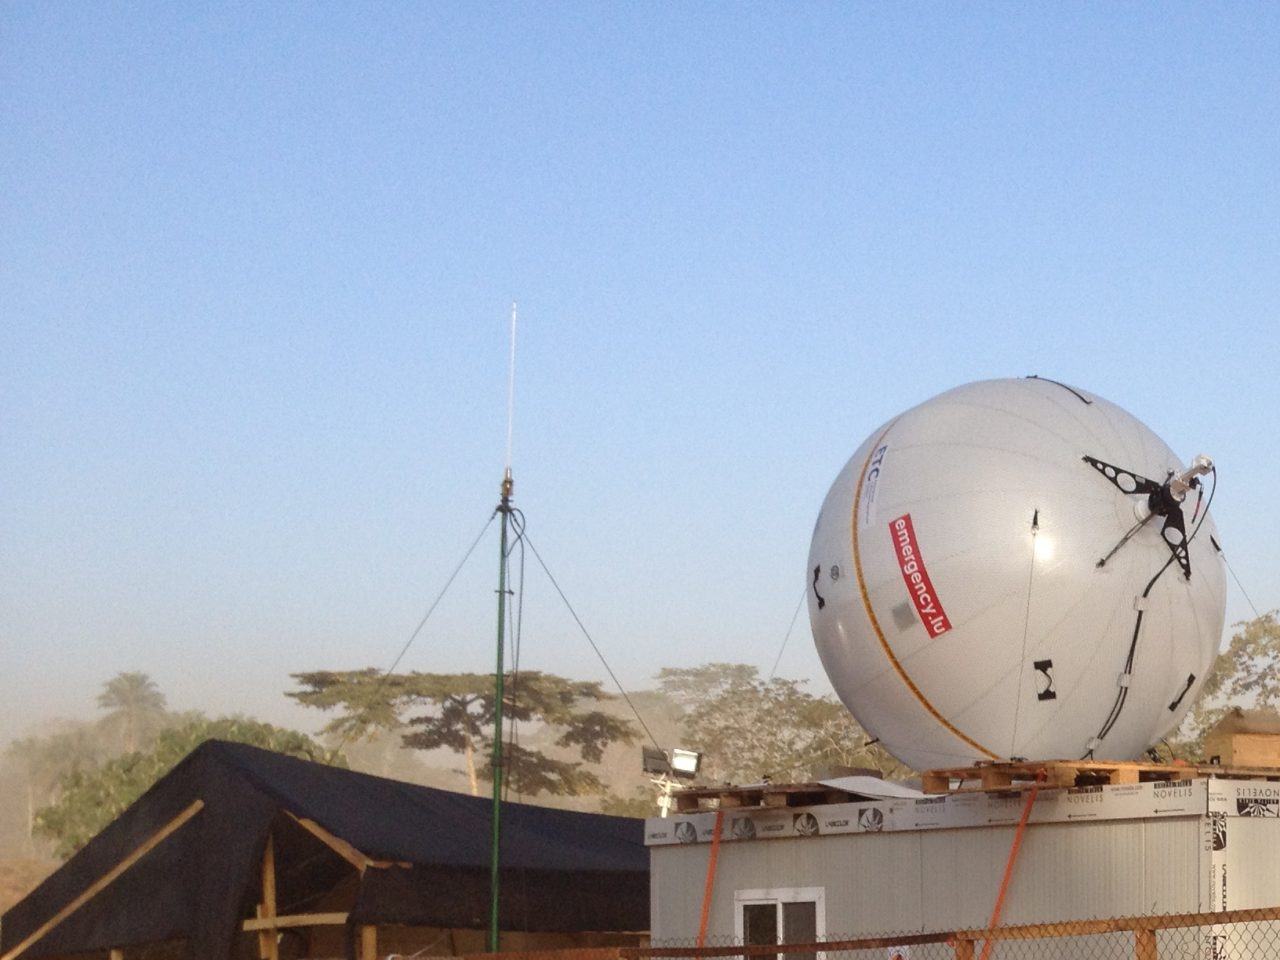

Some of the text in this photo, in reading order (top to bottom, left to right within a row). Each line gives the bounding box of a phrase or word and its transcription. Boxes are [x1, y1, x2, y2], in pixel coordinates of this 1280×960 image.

[867, 445, 888, 482] ETC
[894, 518, 946, 634] emergency.lu
[1153, 788, 1193, 799] NOVELIS
[1236, 787, 1280, 798] NOVELIS
[1067, 794, 1104, 804] NOVELIS
